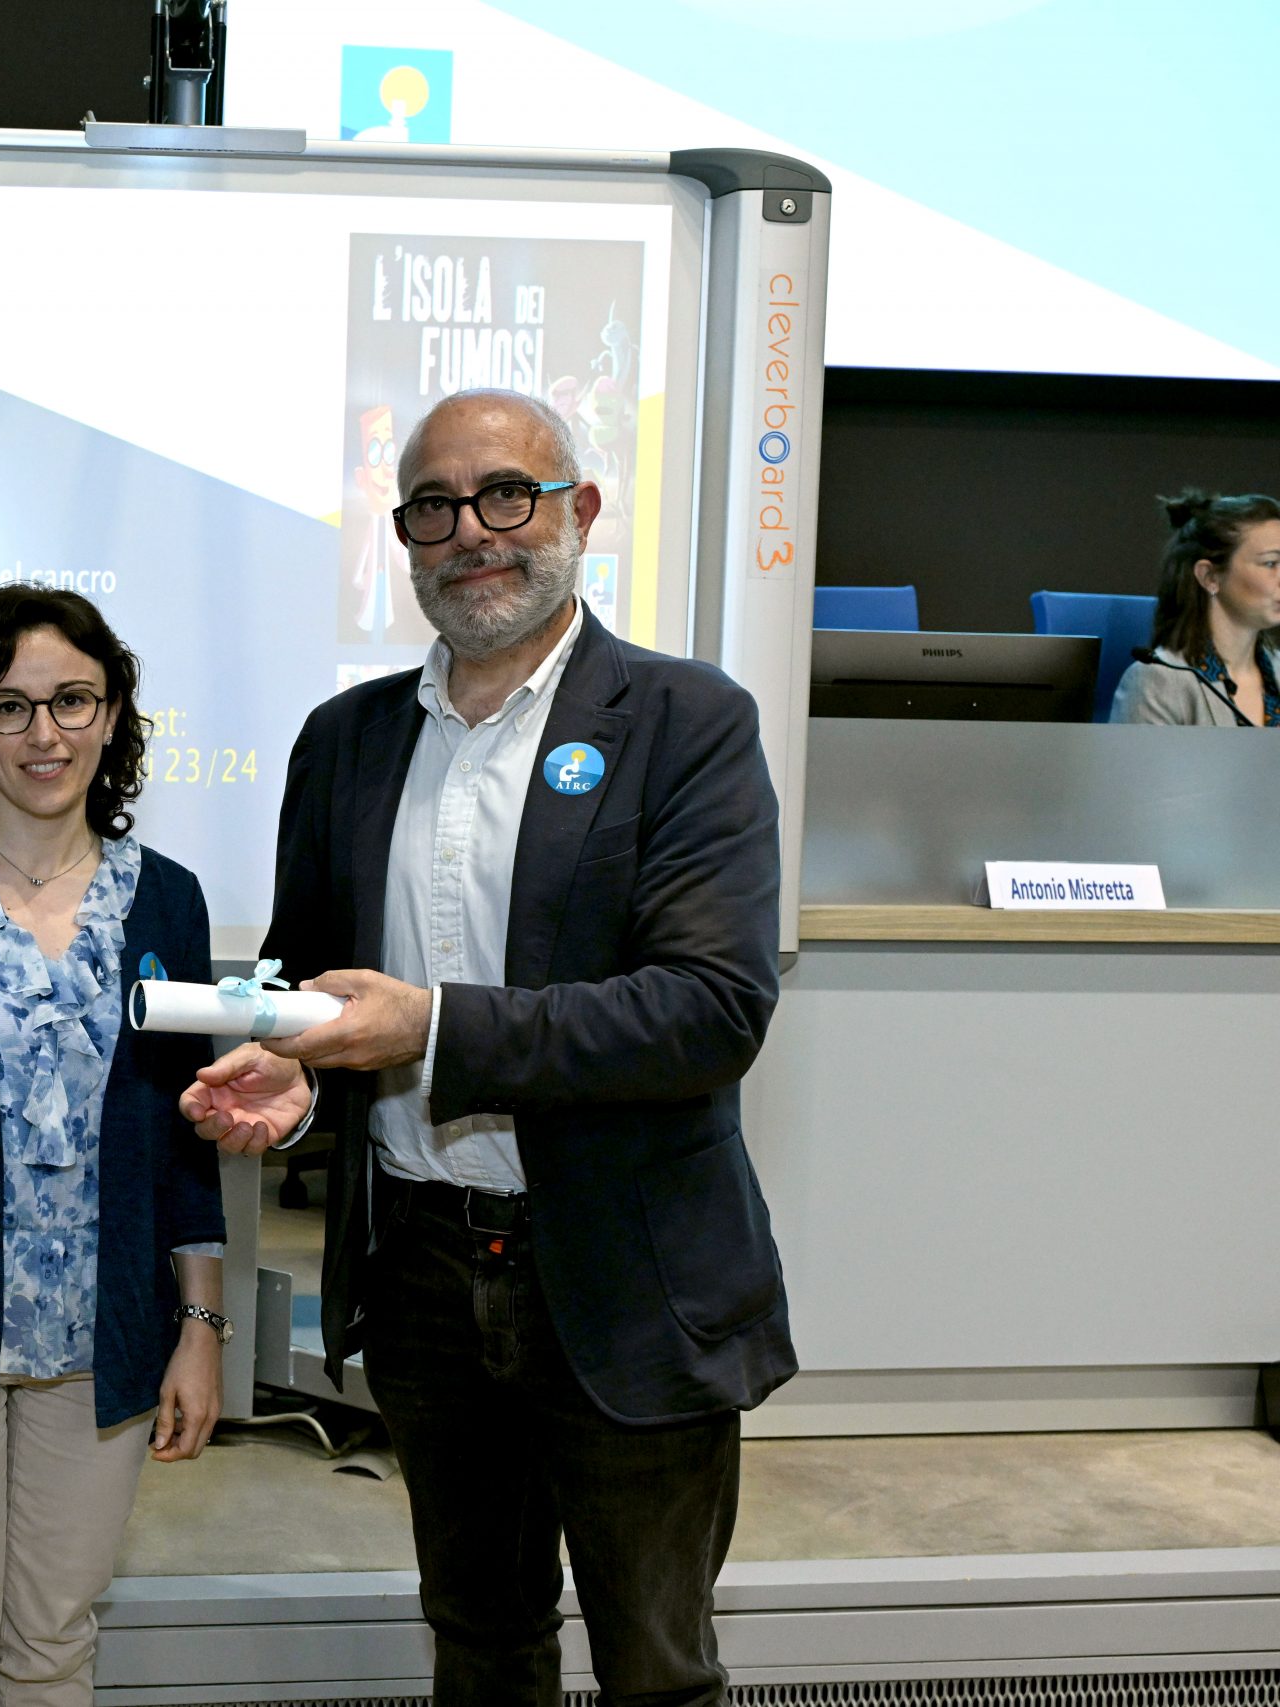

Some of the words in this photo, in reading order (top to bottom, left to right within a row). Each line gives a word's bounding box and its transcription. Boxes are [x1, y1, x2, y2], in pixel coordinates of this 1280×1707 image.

[372, 245, 492, 323] L'ISOLA
[515, 285, 545, 324] DEI
[420, 326, 544, 397] FUMOSI
[29, 569, 117, 594] cancro
[922, 649, 963, 658] PHILIPS
[164, 748, 258, 789] 23/24
[556, 781, 591, 791] AIRC
[1011, 877, 1066, 900] Antonio
[1068, 878, 1135, 900] Mistretta
